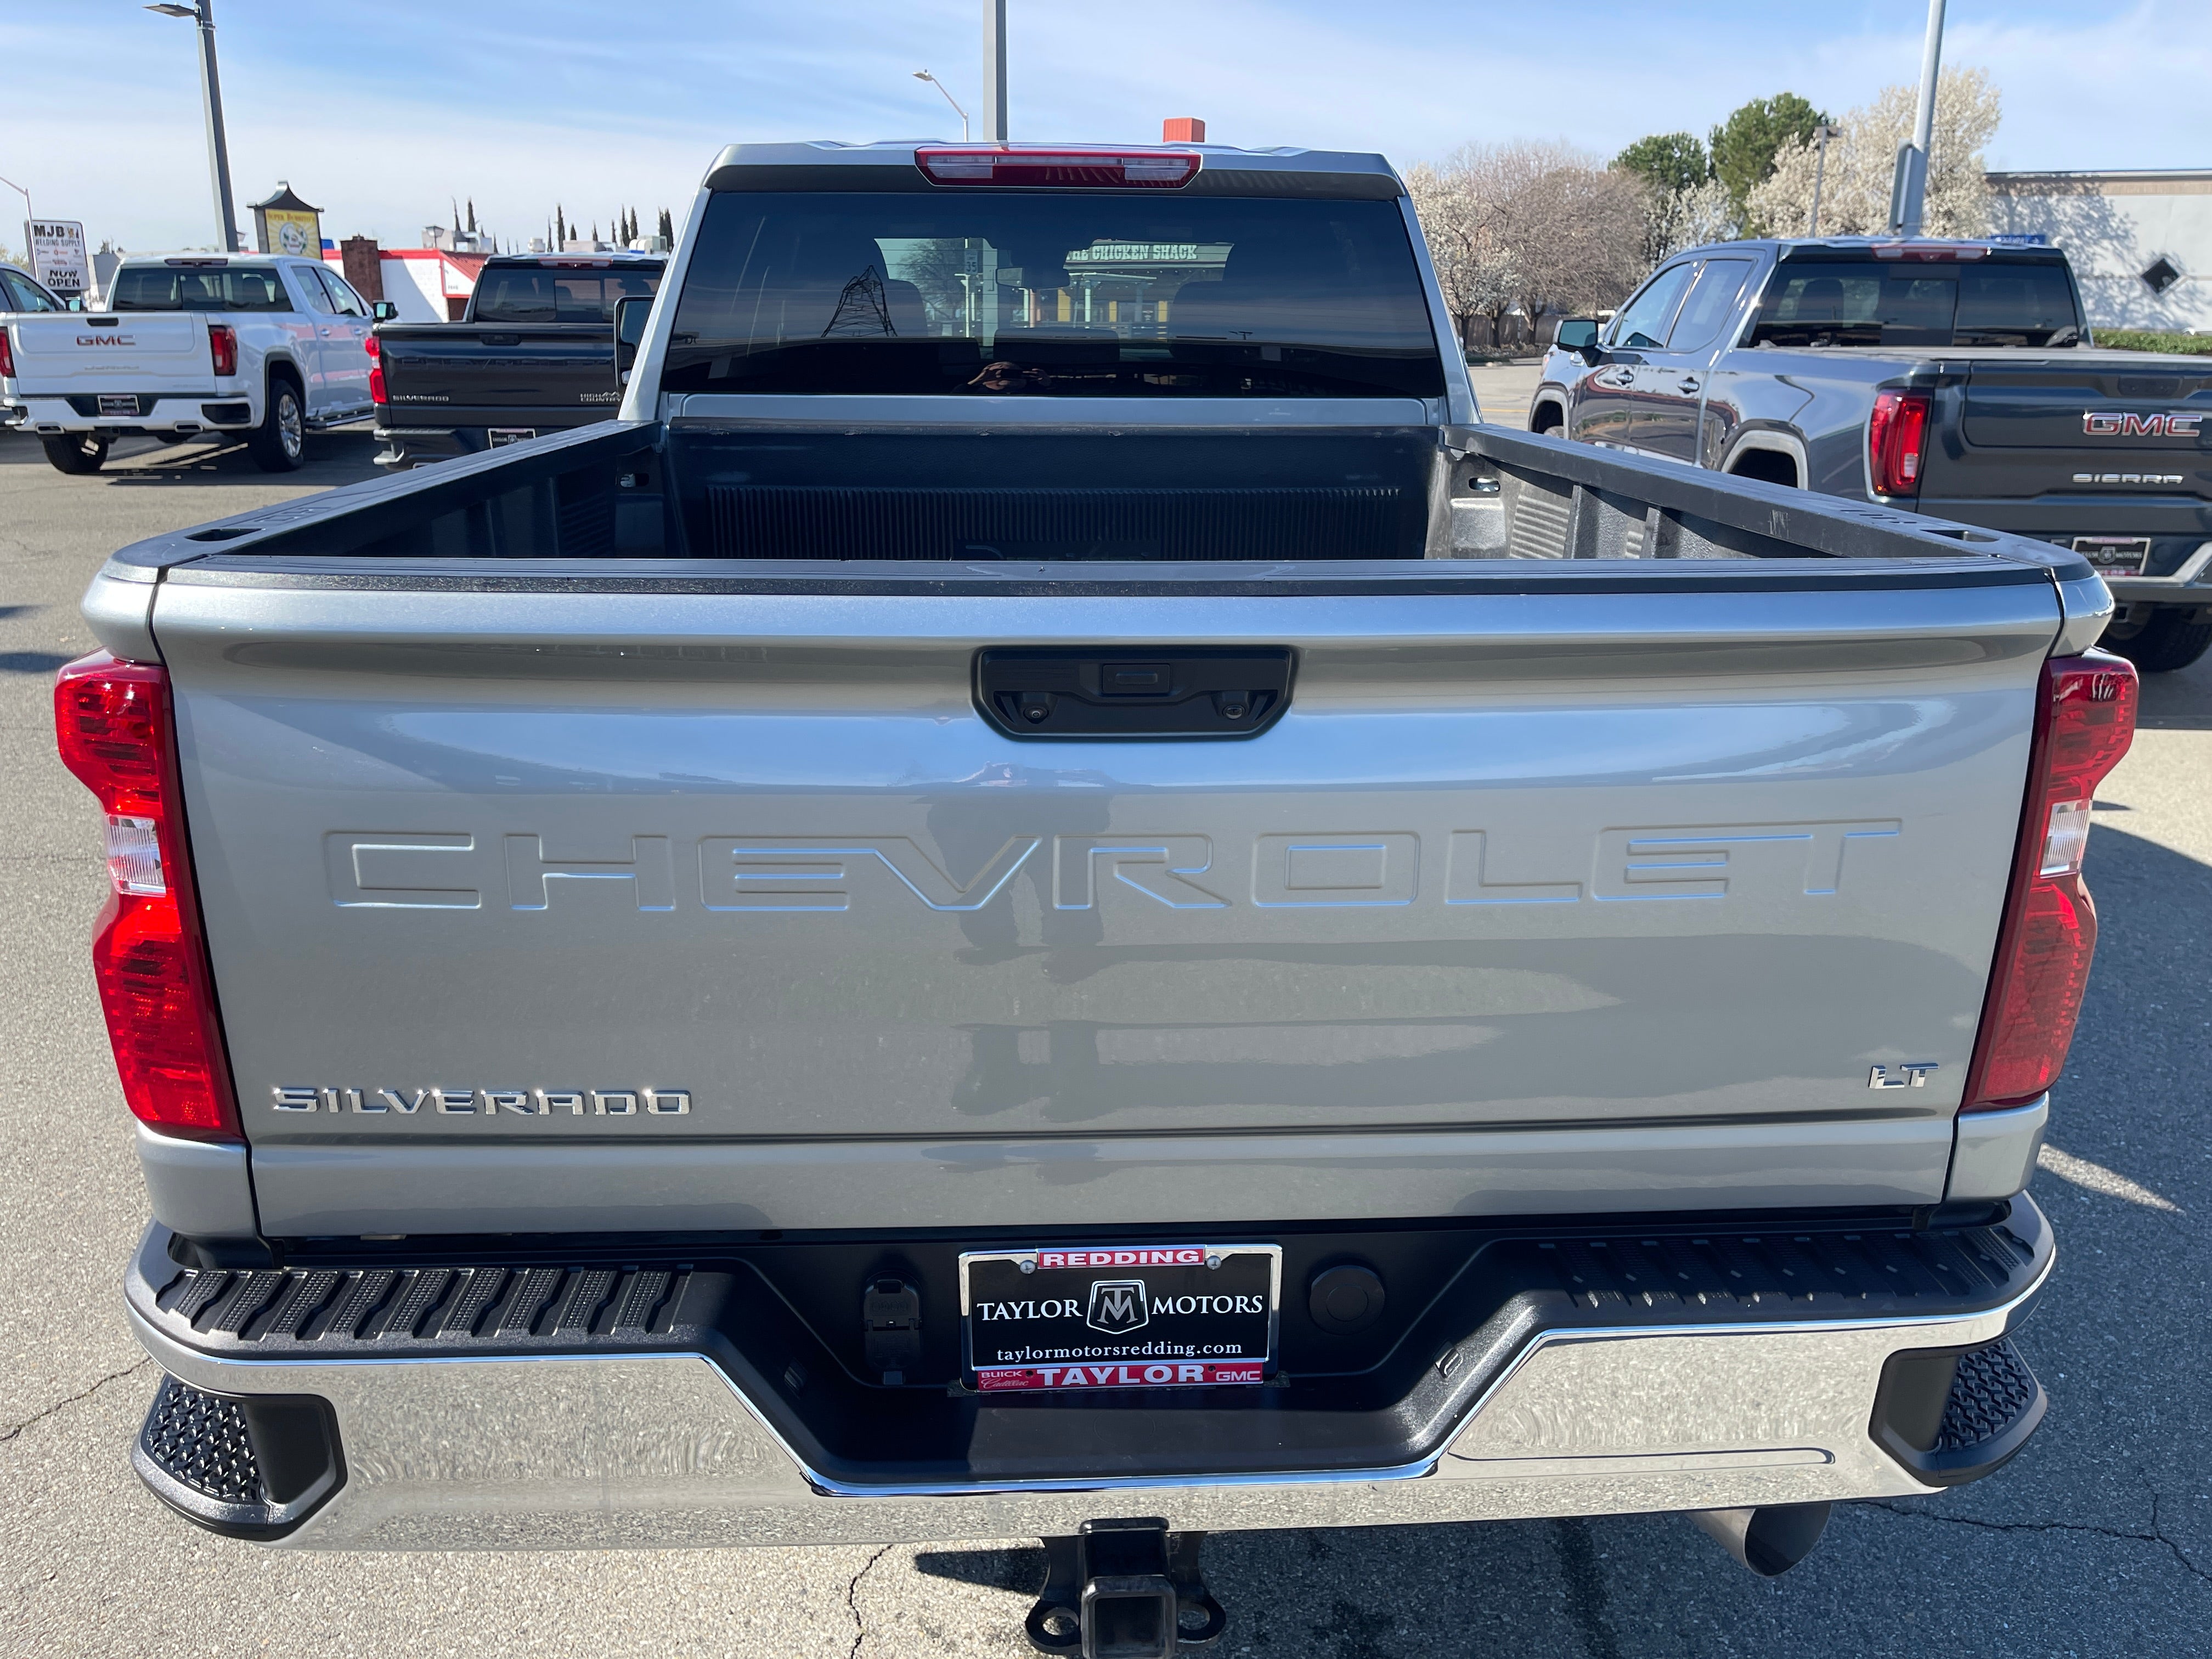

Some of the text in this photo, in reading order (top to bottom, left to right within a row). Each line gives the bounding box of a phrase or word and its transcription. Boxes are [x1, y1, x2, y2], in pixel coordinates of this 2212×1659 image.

[1092, 245, 1149, 260] CHICKEN
[1153, 245, 1197, 259] SHACK
[967, 261, 977, 273] 35
[48, 278, 80, 287] OPEN
[76, 335, 136, 346] GMC
[2083, 413, 2202, 437] GMC
[2072, 473, 2184, 484] SIERRA
[325, 819, 1902, 912] CHEVROLET
[1868, 1063, 1939, 1089] LT
[272, 1087, 692, 1116] SILVERADO
[1043, 1250, 1199, 1266] REDDING
[977, 1295, 1263, 1321] TAYLOR MOTORS
[997, 1341, 1242, 1363] taylormotorsredding.com
[981, 1378, 1030, 1389] Cadillac
[1036, 1365, 1204, 1386] TAYLOR
[1216, 1370, 1261, 1381] GMC
